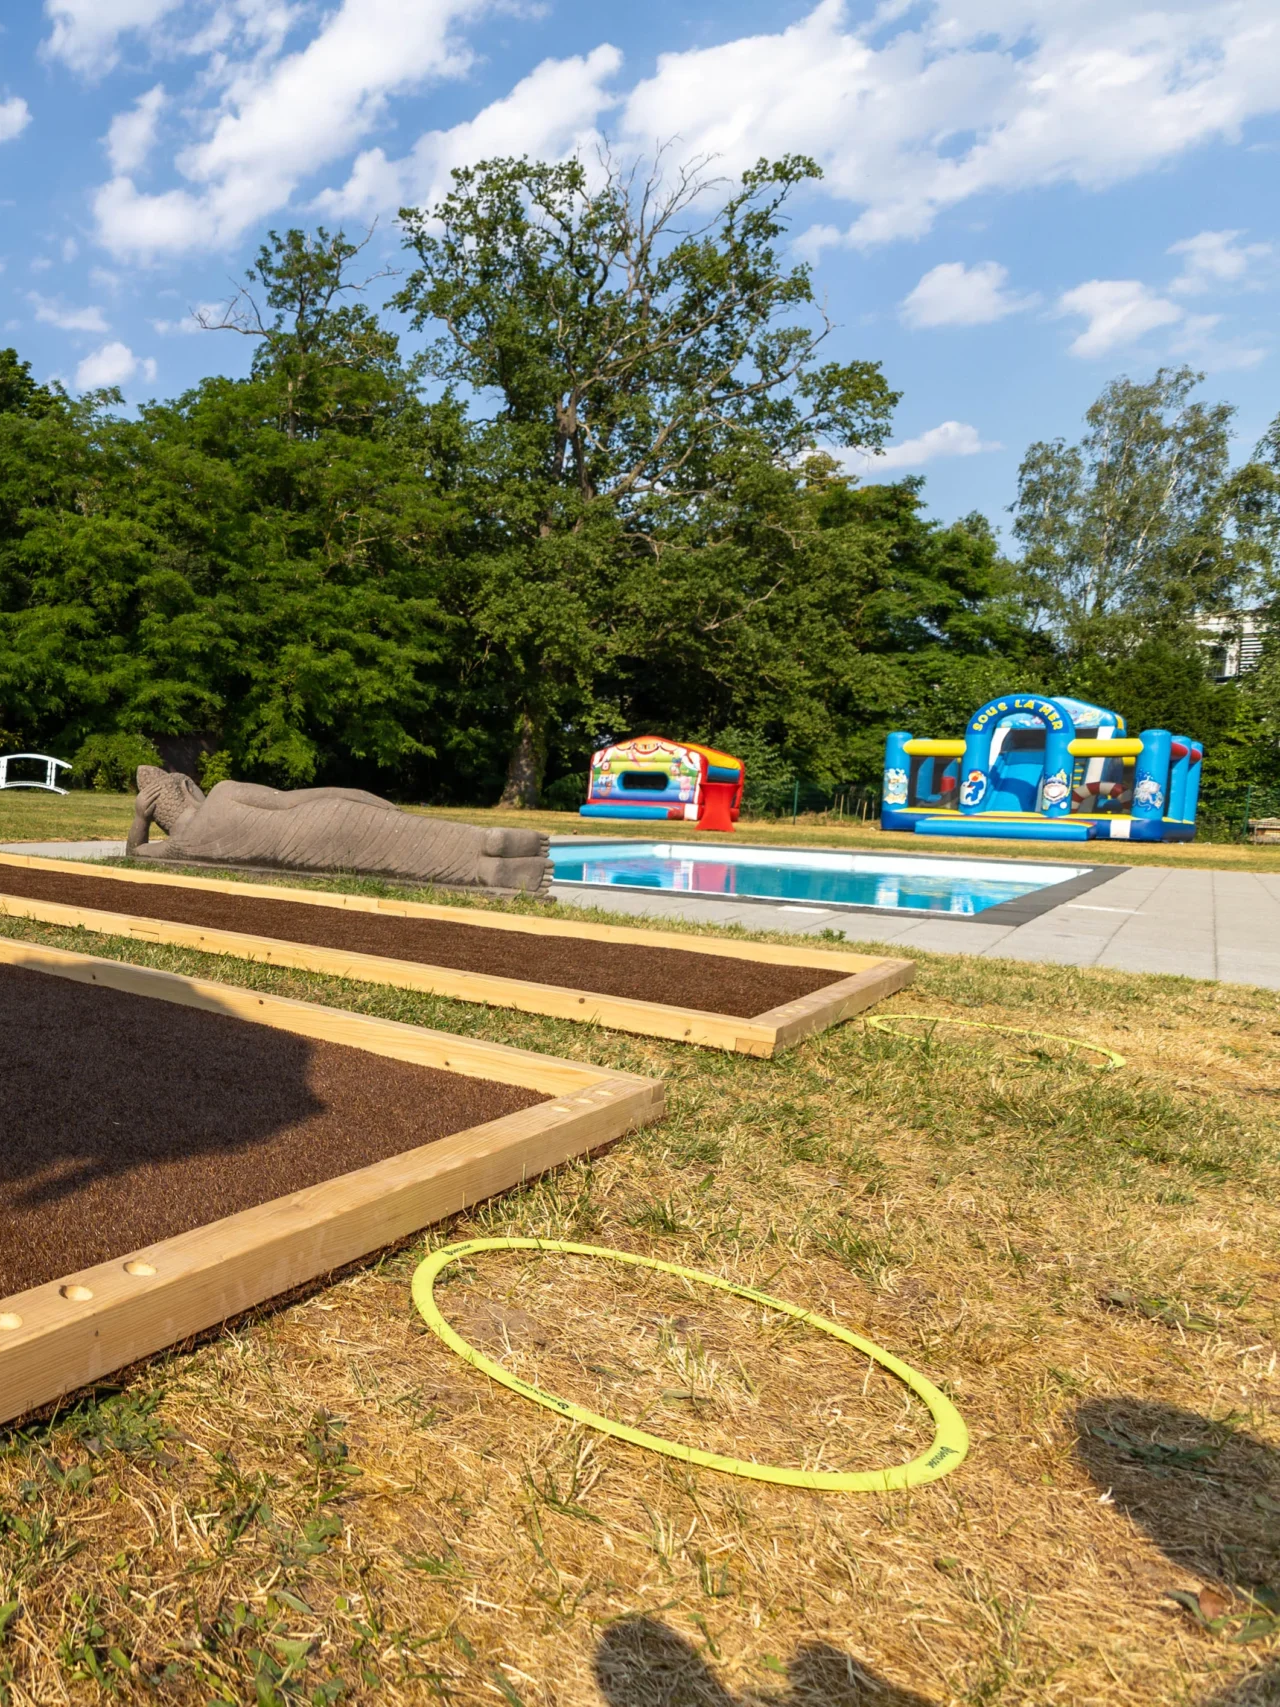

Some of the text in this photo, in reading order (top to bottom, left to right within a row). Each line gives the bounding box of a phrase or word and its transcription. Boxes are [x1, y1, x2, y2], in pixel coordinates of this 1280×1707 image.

[972, 699, 1063, 731] SOUS LA MER
